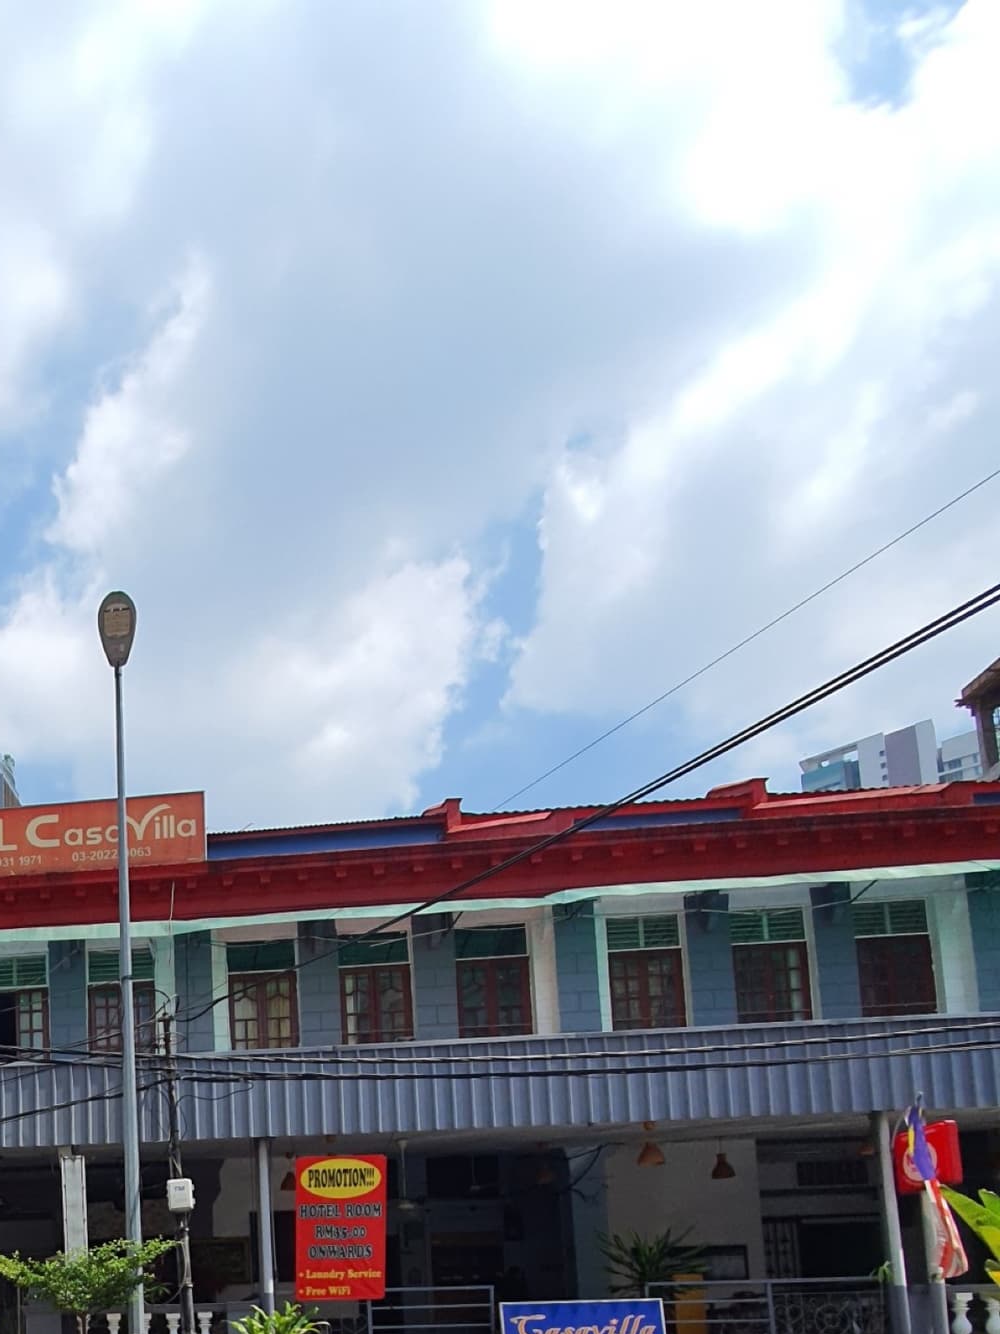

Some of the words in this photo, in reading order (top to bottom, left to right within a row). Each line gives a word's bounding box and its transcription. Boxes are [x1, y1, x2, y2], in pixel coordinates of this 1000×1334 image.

[18, 855, 42, 867] 1971
[308, 1167, 375, 1188] PROMOTION!!!
[299, 1204, 341, 1218] HOTEL
[345, 1203, 382, 1217] ROOM
[308, 1245, 373, 1259] ONWARDS
[305, 1269, 345, 1281] Laundry
[347, 1268, 382, 1279] Service
[305, 1286, 327, 1297] Free
